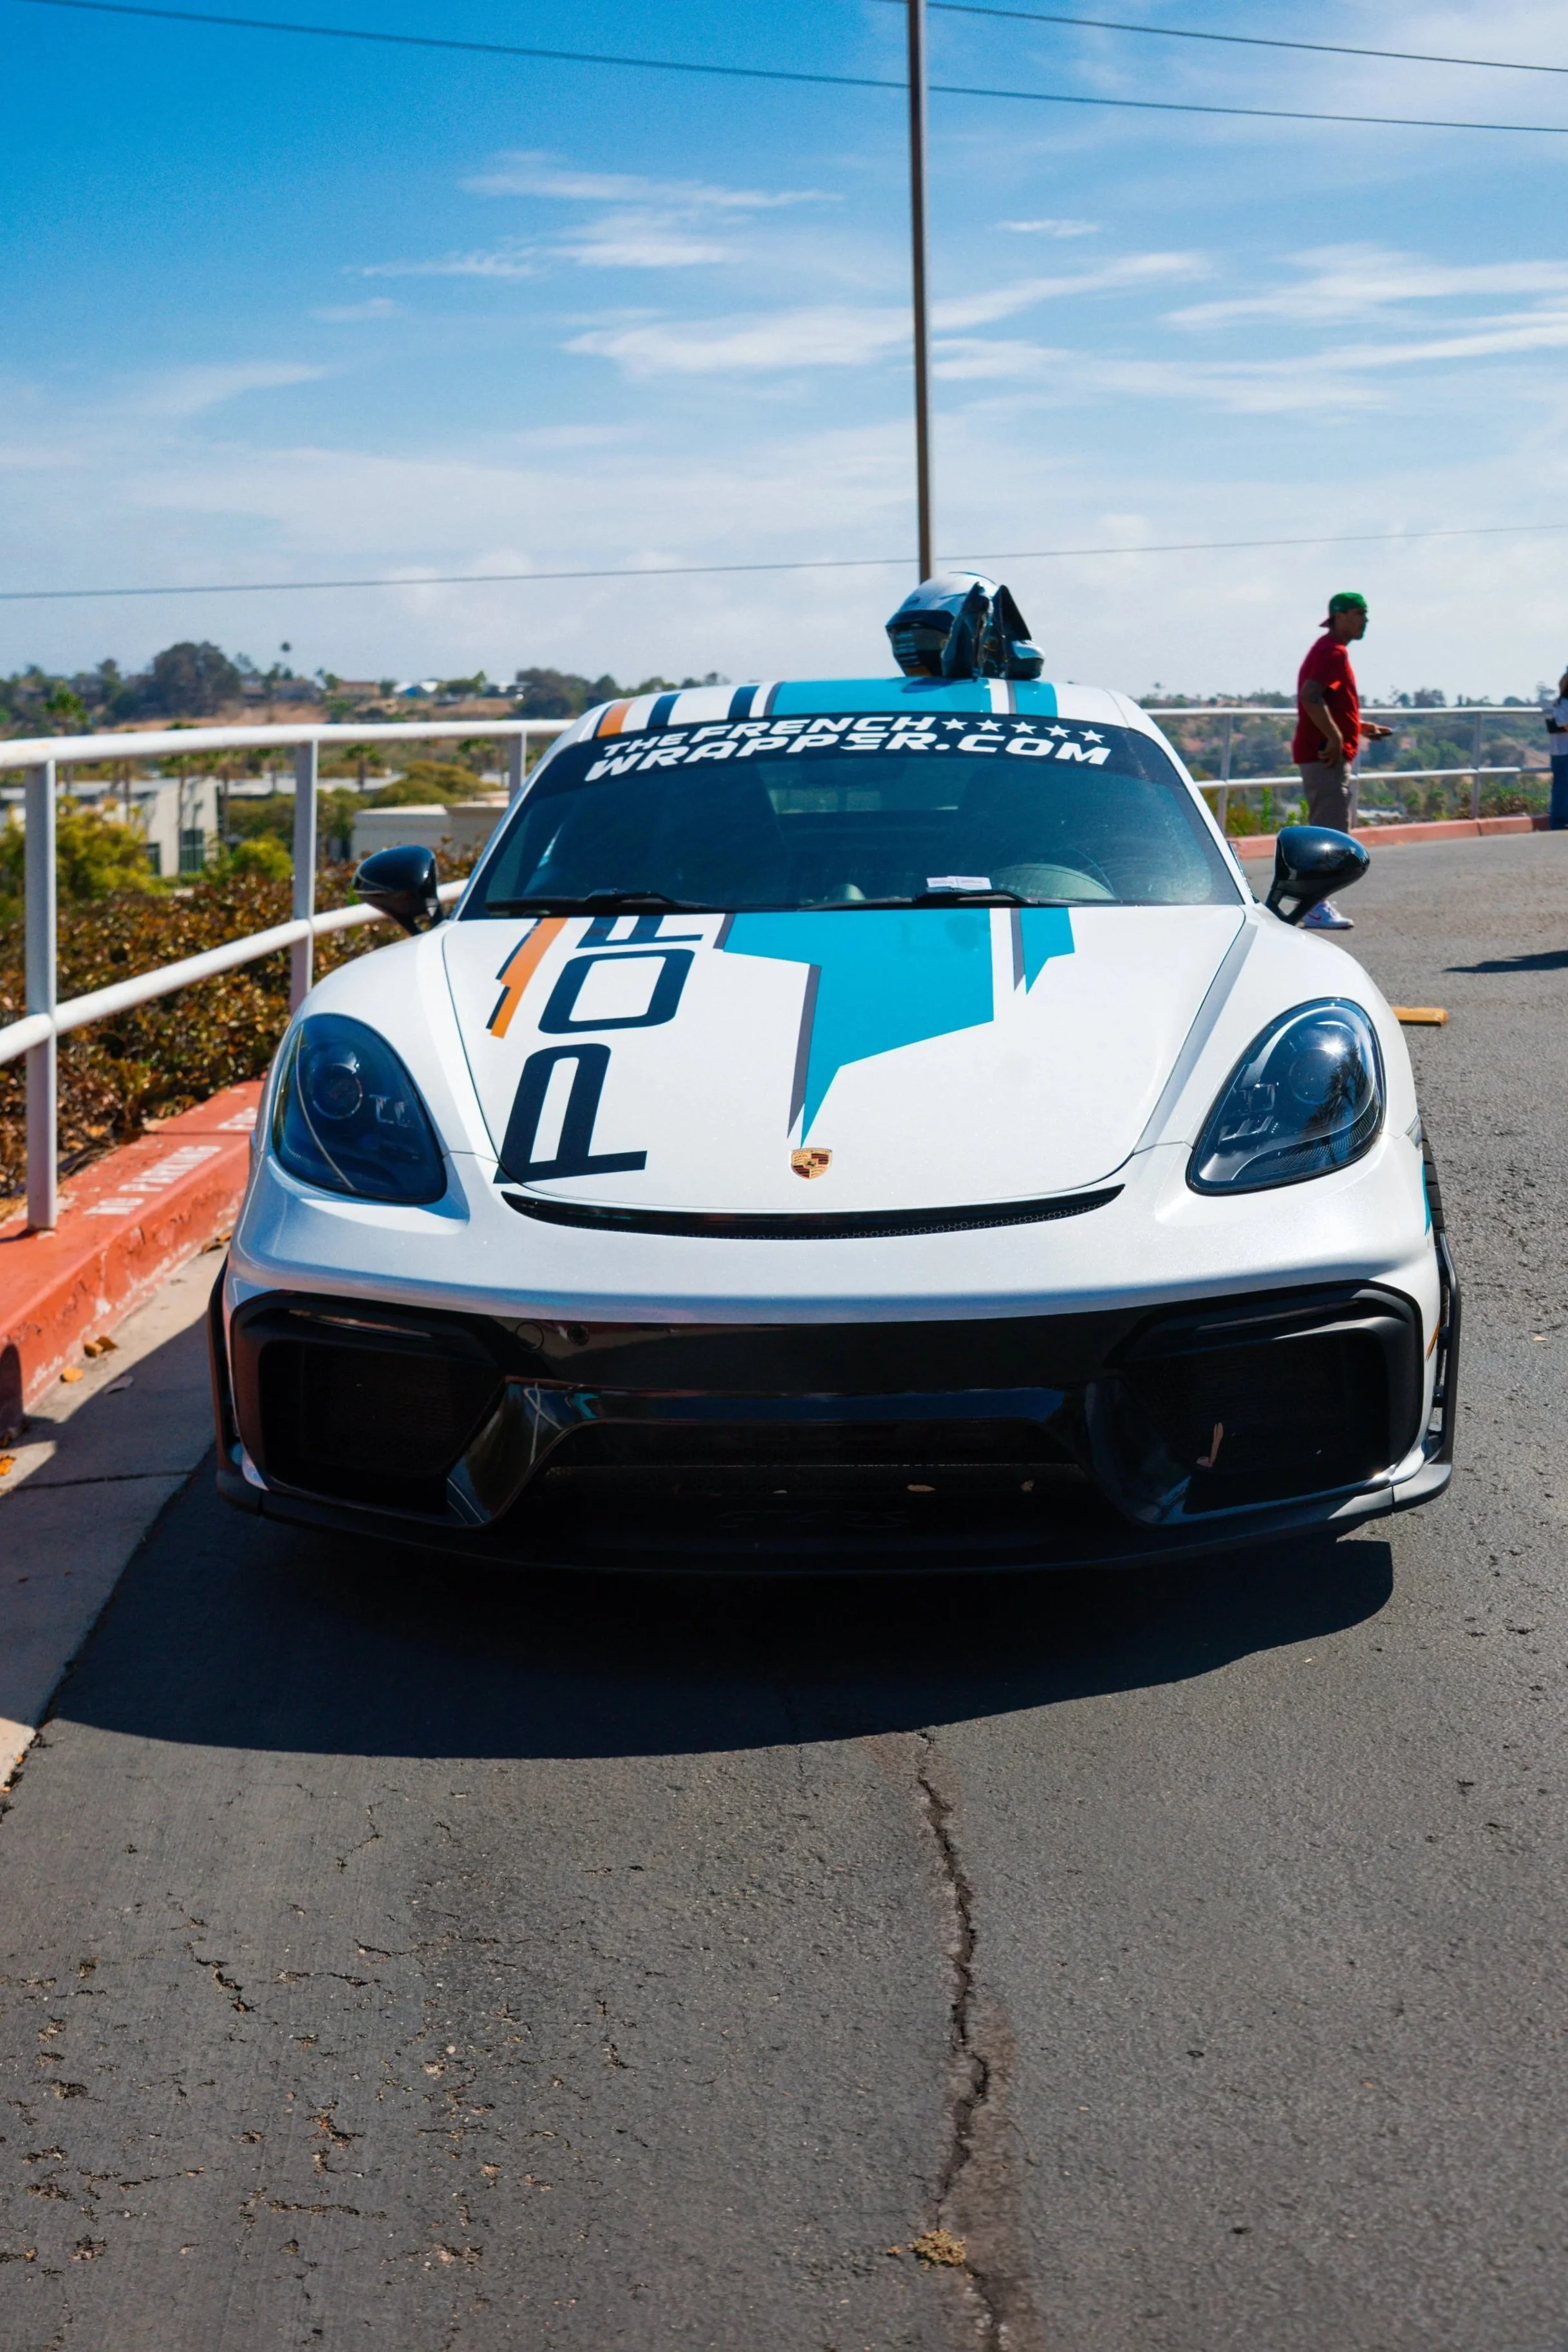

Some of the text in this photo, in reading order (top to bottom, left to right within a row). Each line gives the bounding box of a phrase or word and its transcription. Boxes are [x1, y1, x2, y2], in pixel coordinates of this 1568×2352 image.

[584, 732, 1112, 782] WRAPPER.COM
[604, 716, 937, 758] THE FRENCH
